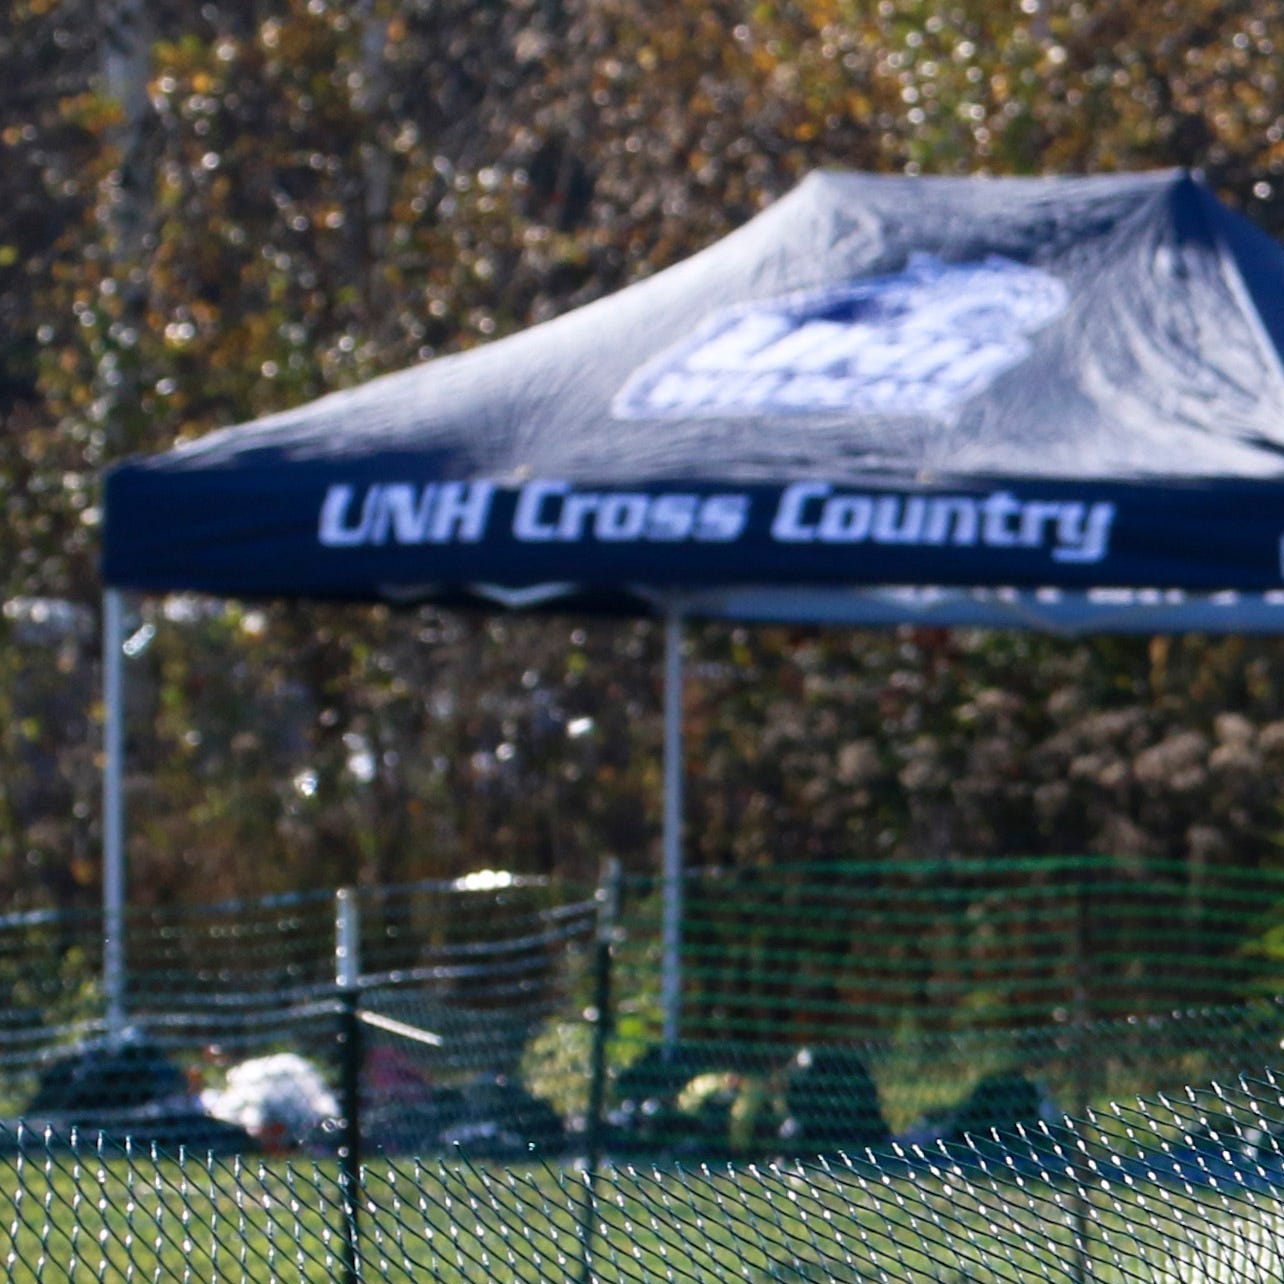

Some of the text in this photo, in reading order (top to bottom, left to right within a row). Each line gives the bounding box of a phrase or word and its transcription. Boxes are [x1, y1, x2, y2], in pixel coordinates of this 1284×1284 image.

[318, 479, 1116, 564] UNH Cross Country
